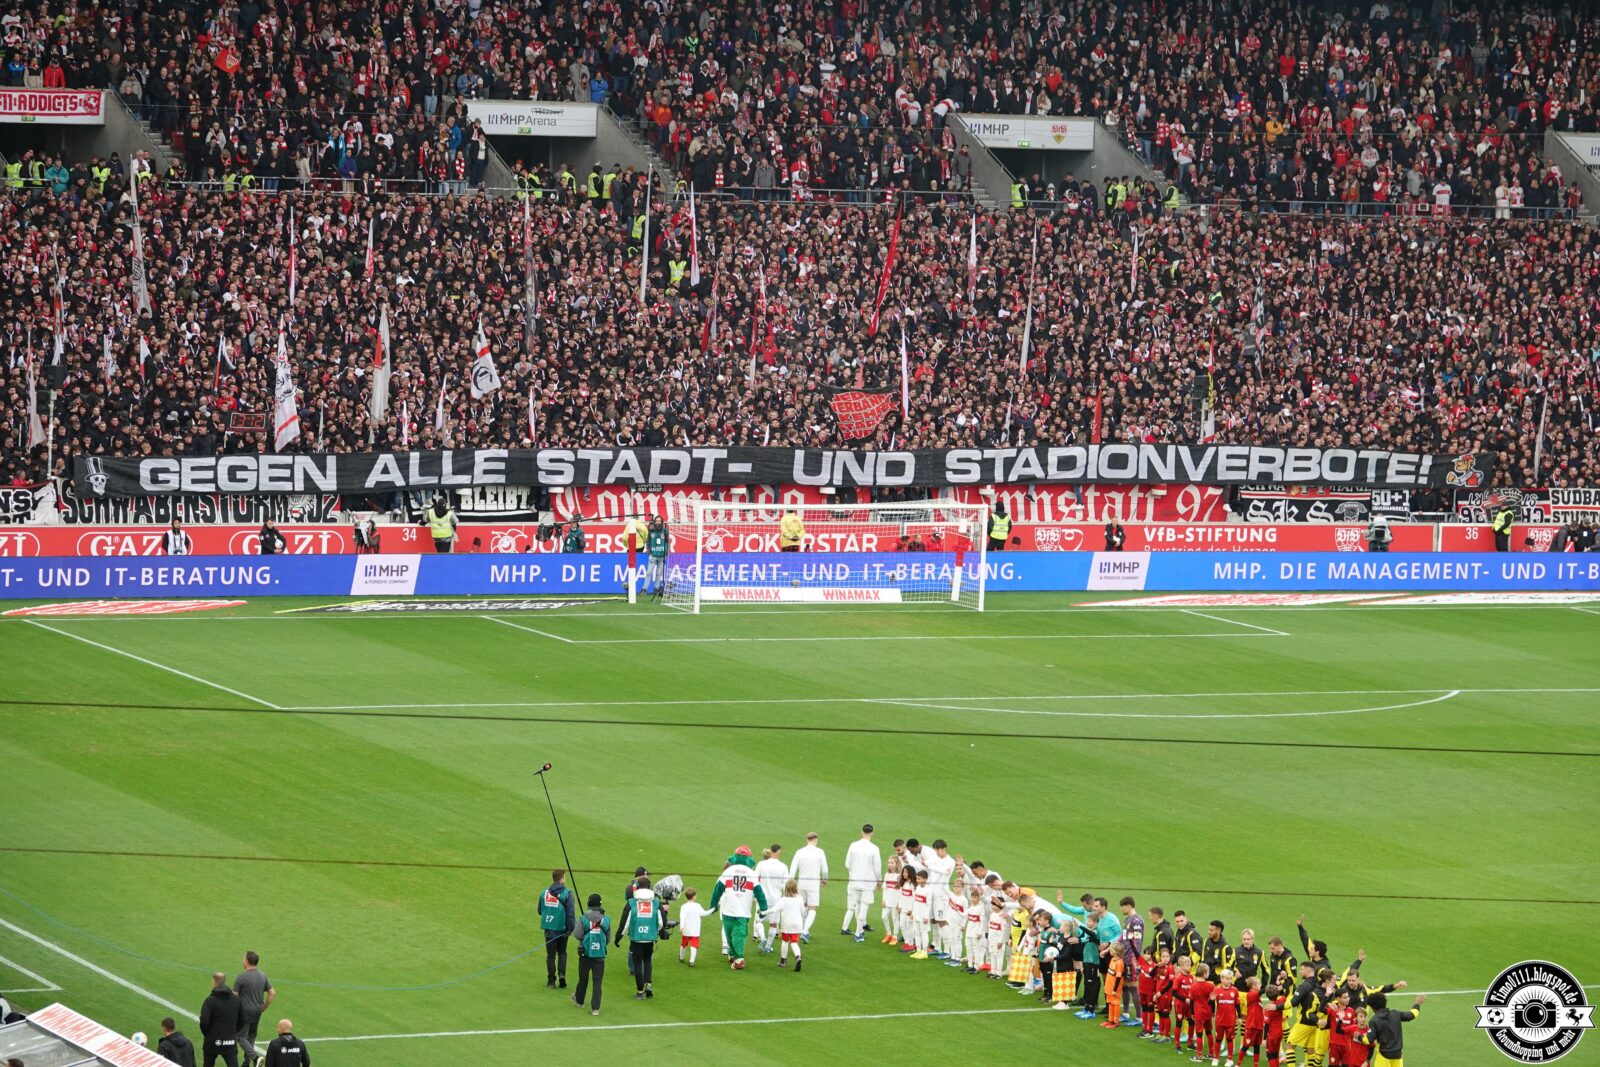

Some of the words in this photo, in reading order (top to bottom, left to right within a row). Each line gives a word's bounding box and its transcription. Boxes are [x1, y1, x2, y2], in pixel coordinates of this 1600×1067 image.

[500, 115, 524, 124] MHP
[526, 115, 557, 126] Arena
[983, 124, 1009, 135] MHP
[139, 455, 337, 491] GEGEN
[365, 450, 506, 488] ALLE
[537, 449, 753, 484] STADT-
[792, 451, 915, 486] UND
[945, 445, 1432, 484] STADIONVERBOTE!
[1372, 490, 1410, 507] 50+1
[402, 528, 417, 541] 34
[1144, 527, 1277, 543] VfB-STIFTUNG
[1465, 528, 1478, 540] 36
[733, 534, 878, 553] JOKRSTAR
[380, 565, 409, 577] MHP
[490, 564, 547, 582] MHP.
[562, 564, 600, 582] DIE
[803, 563, 850, 581] UND
[1113, 562, 1140, 573] MHP
[1213, 562, 1266, 580] MHP.
[1280, 562, 1316, 580] DIE
[1328, 562, 1489, 580] MANAGEMENT-
[1502, 563, 1546, 580] UND
[38, 568, 90, 587] UND
[105, 566, 280, 586] IT-BERATUNG.
[722, 588, 781, 600] WINAMAX
[822, 588, 880, 600] WINAMAX
[732, 875, 747, 892] 92
